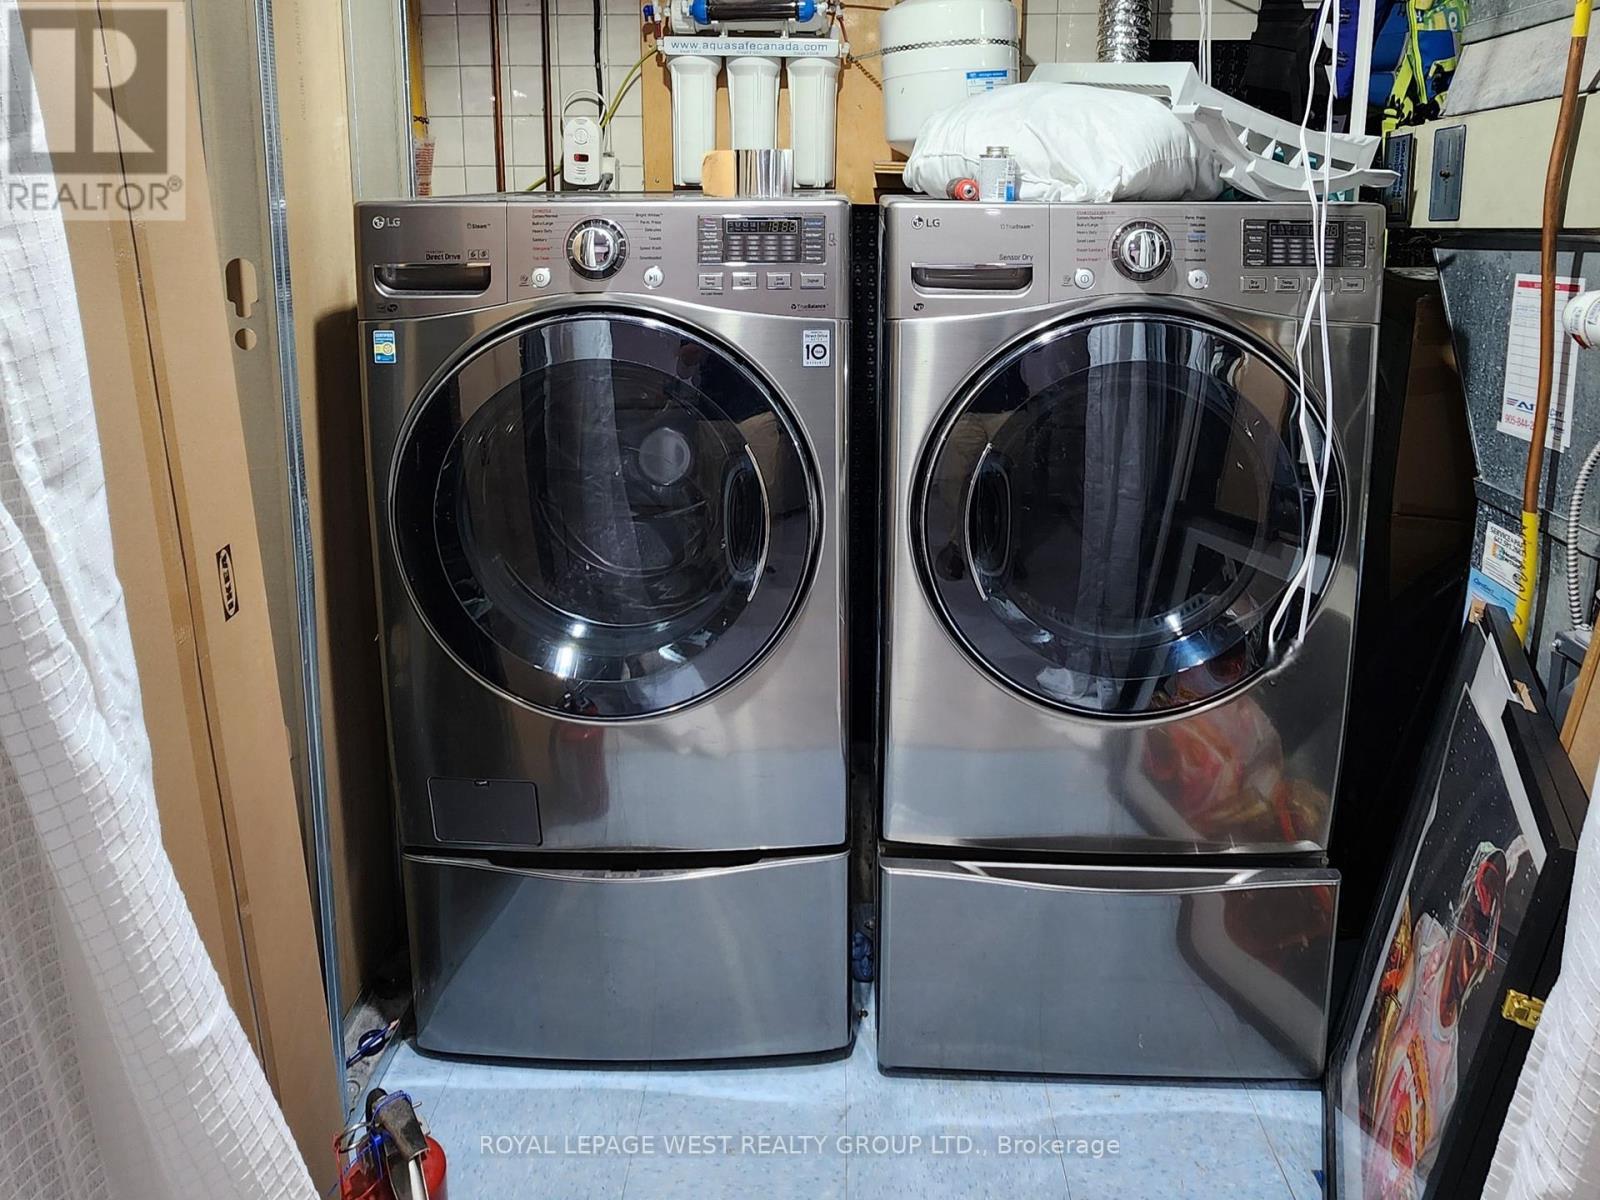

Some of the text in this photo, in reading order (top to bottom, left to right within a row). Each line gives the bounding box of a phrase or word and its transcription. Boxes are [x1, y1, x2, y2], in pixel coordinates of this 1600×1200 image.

[671, 40, 829, 53] www.aquasafecanada.com
[387, 218, 400, 227] LG
[926, 218, 940, 228] LG
[425, 252, 461, 261] Direct Drive
[999, 253, 1034, 262] Sensor Dry
[805, 344, 827, 360] 10
